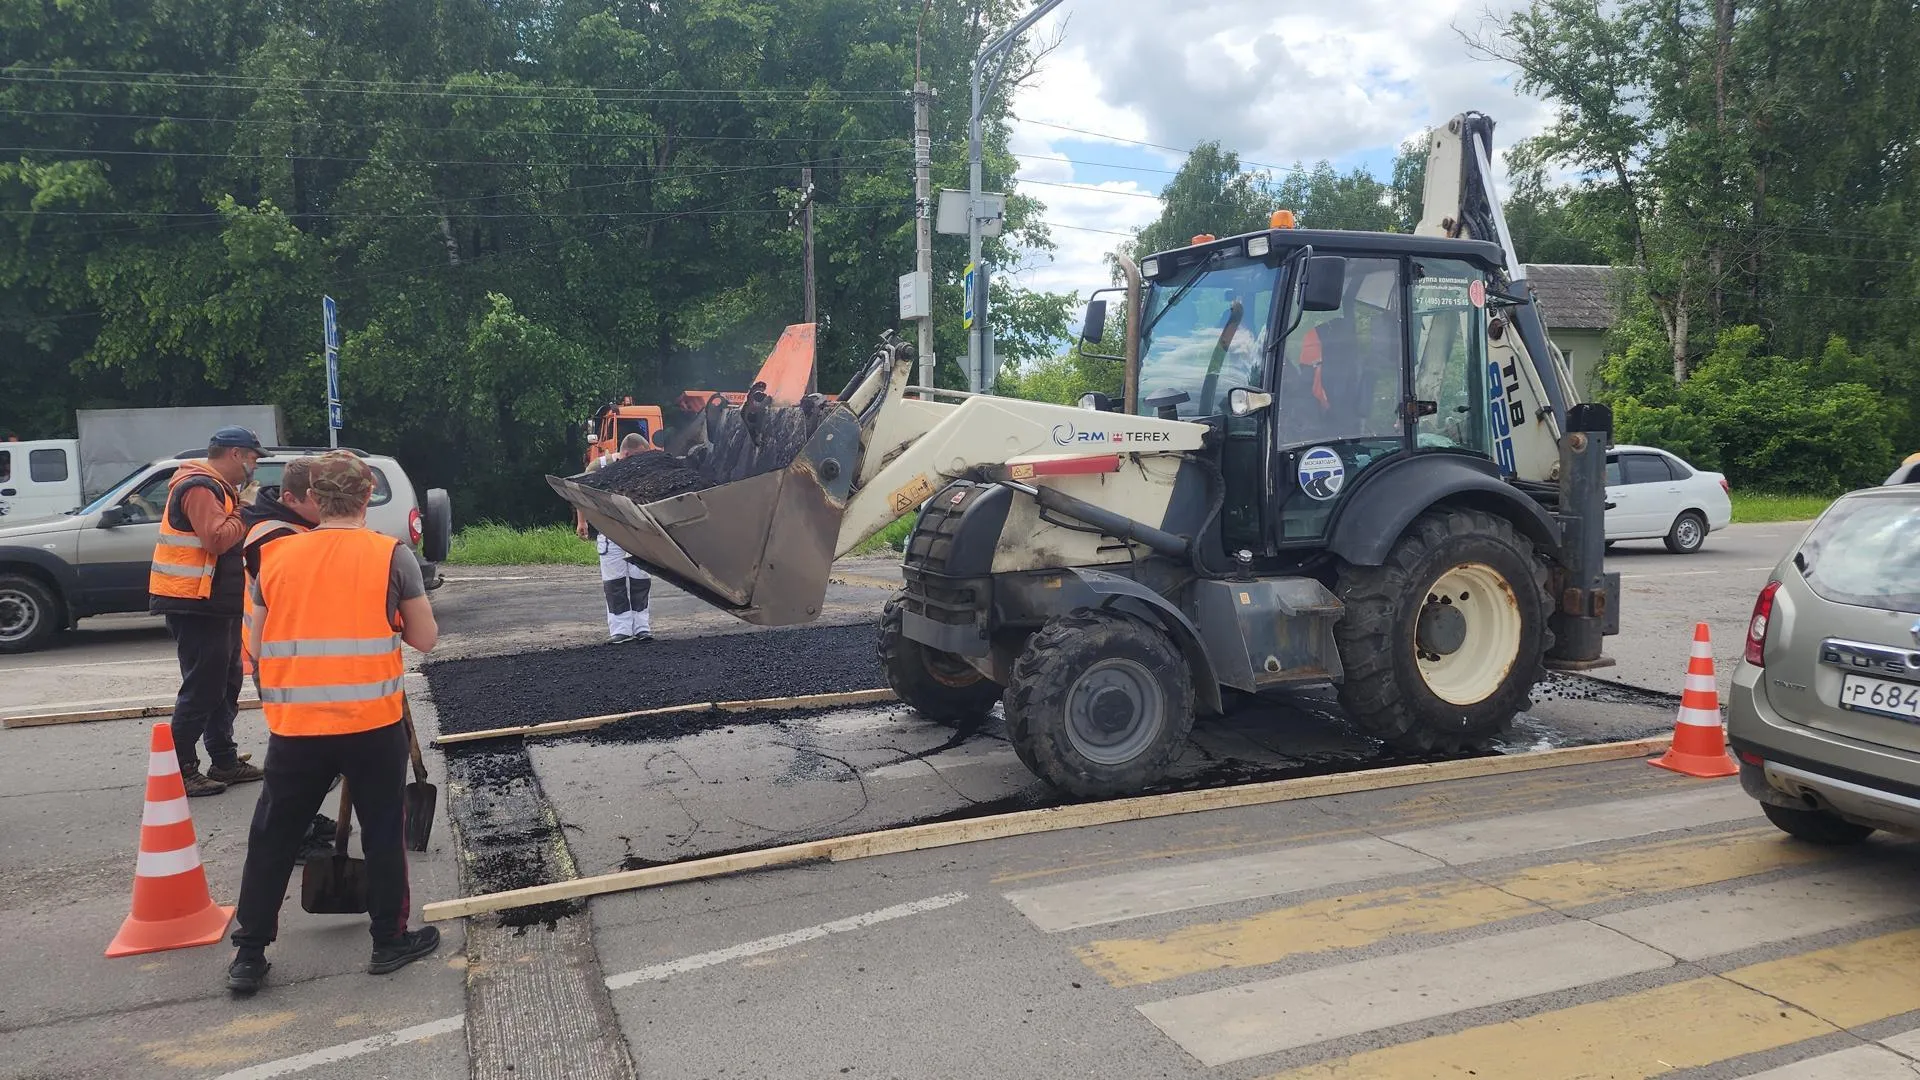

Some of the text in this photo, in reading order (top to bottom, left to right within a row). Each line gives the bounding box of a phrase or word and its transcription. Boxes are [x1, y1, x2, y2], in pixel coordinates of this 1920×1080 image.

[1502, 355, 1525, 428] TLB
[1077, 432, 1170, 442] RM TEREX
